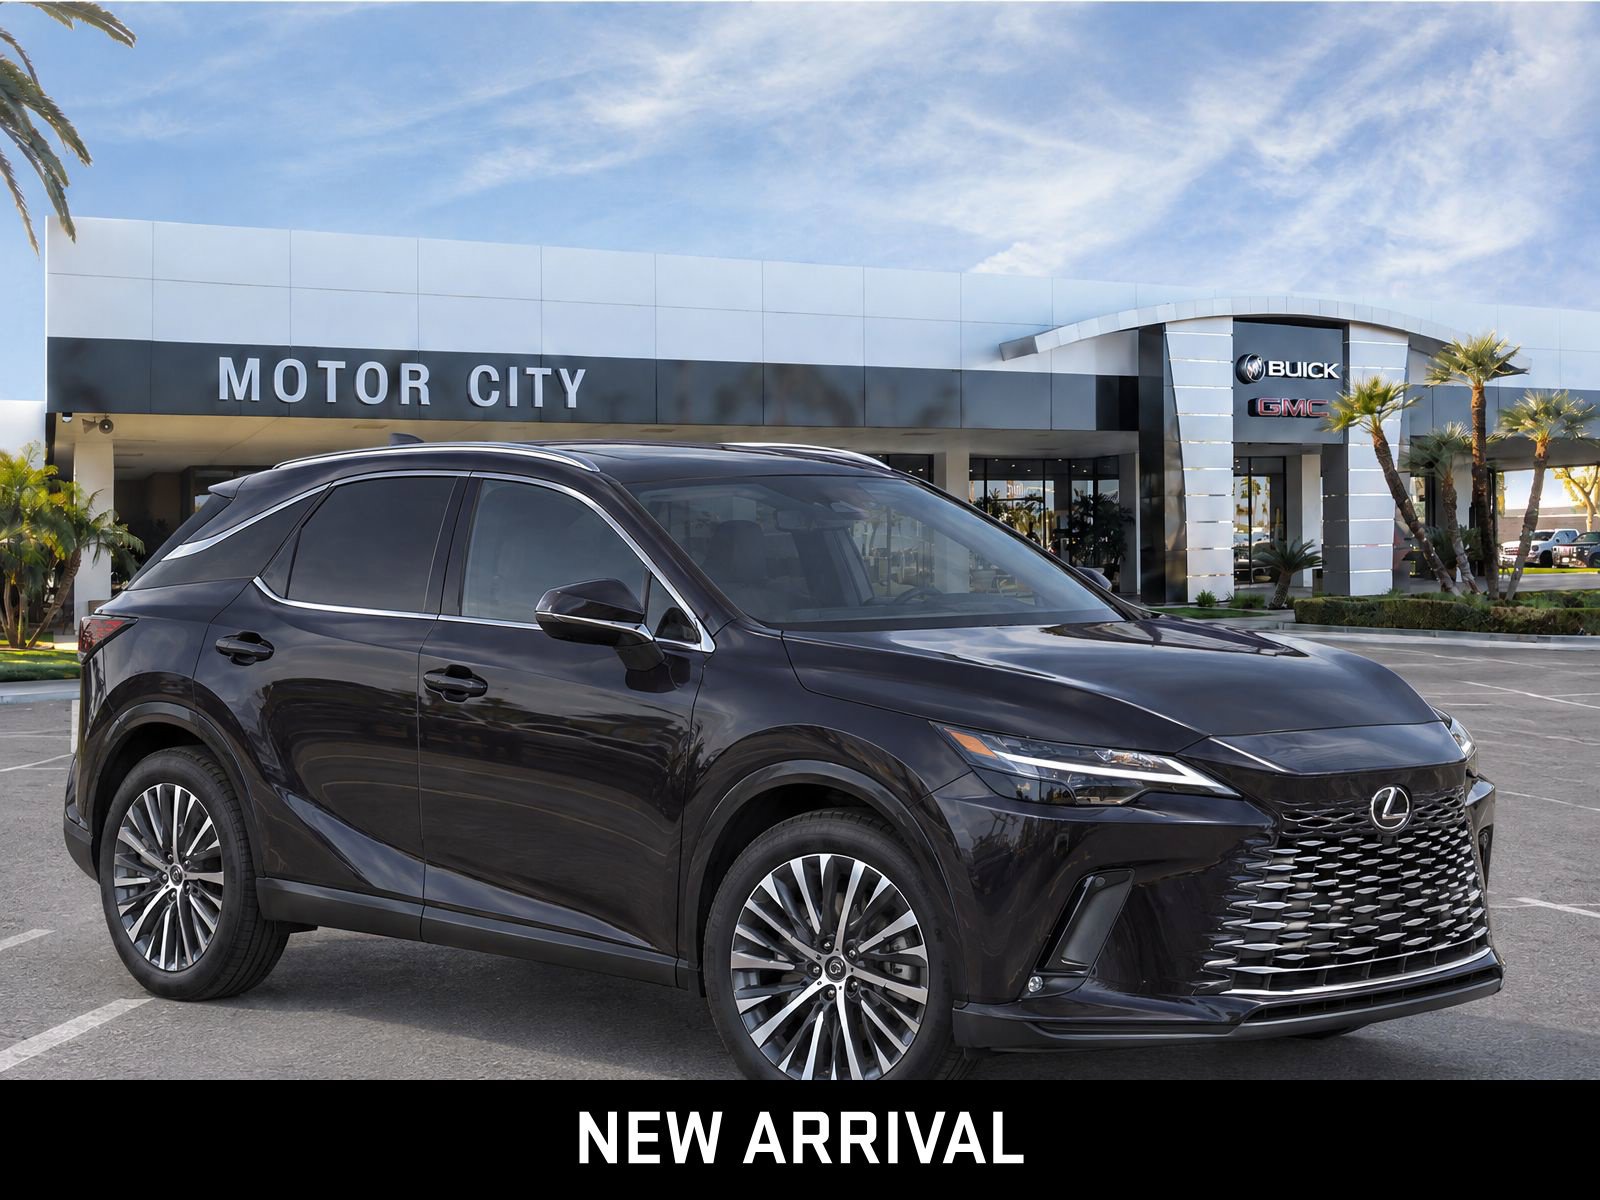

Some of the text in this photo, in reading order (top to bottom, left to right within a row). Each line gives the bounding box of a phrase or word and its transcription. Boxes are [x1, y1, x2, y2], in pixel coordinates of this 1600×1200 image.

[1268, 360, 1340, 379] BUICK
[218, 356, 586, 408] MOTOR CITY
[1257, 397, 1330, 417] GMC
